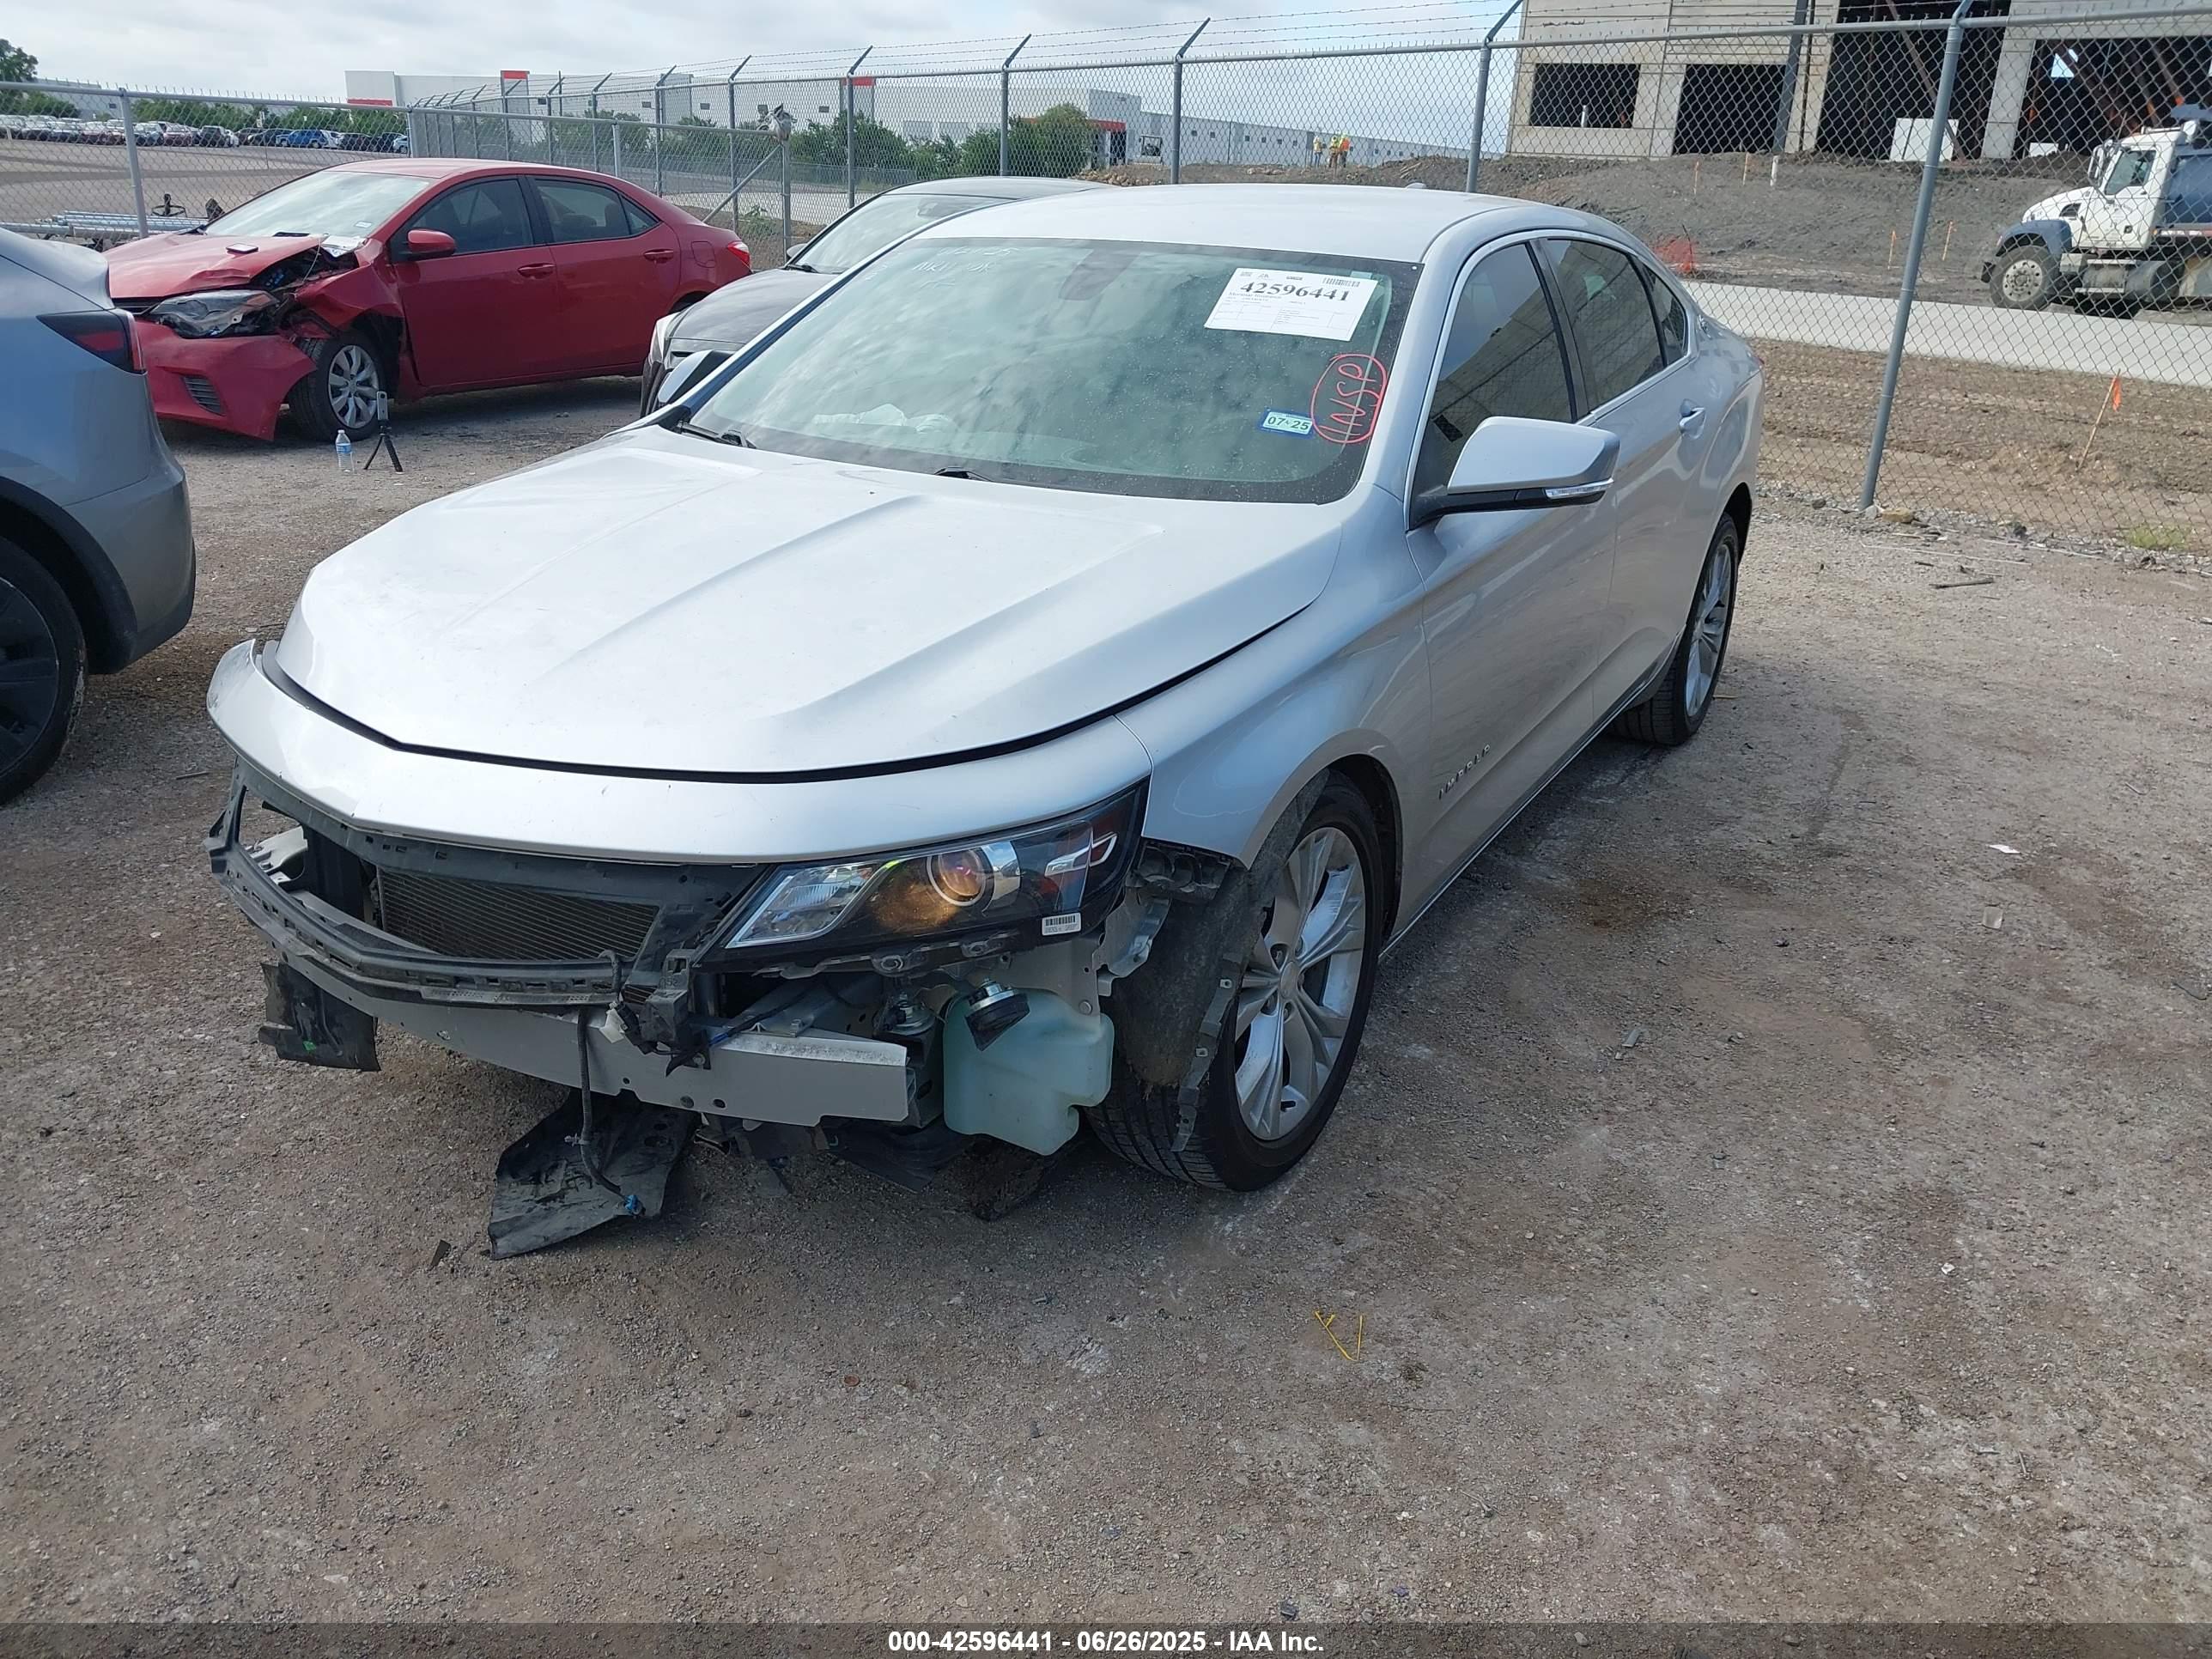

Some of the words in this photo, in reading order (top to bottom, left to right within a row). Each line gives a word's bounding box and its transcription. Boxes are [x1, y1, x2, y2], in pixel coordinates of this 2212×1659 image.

[1240, 281, 1350, 302] 42596441
[1267, 416, 1286, 426] 07
[1290, 420, 1311, 430] 25
